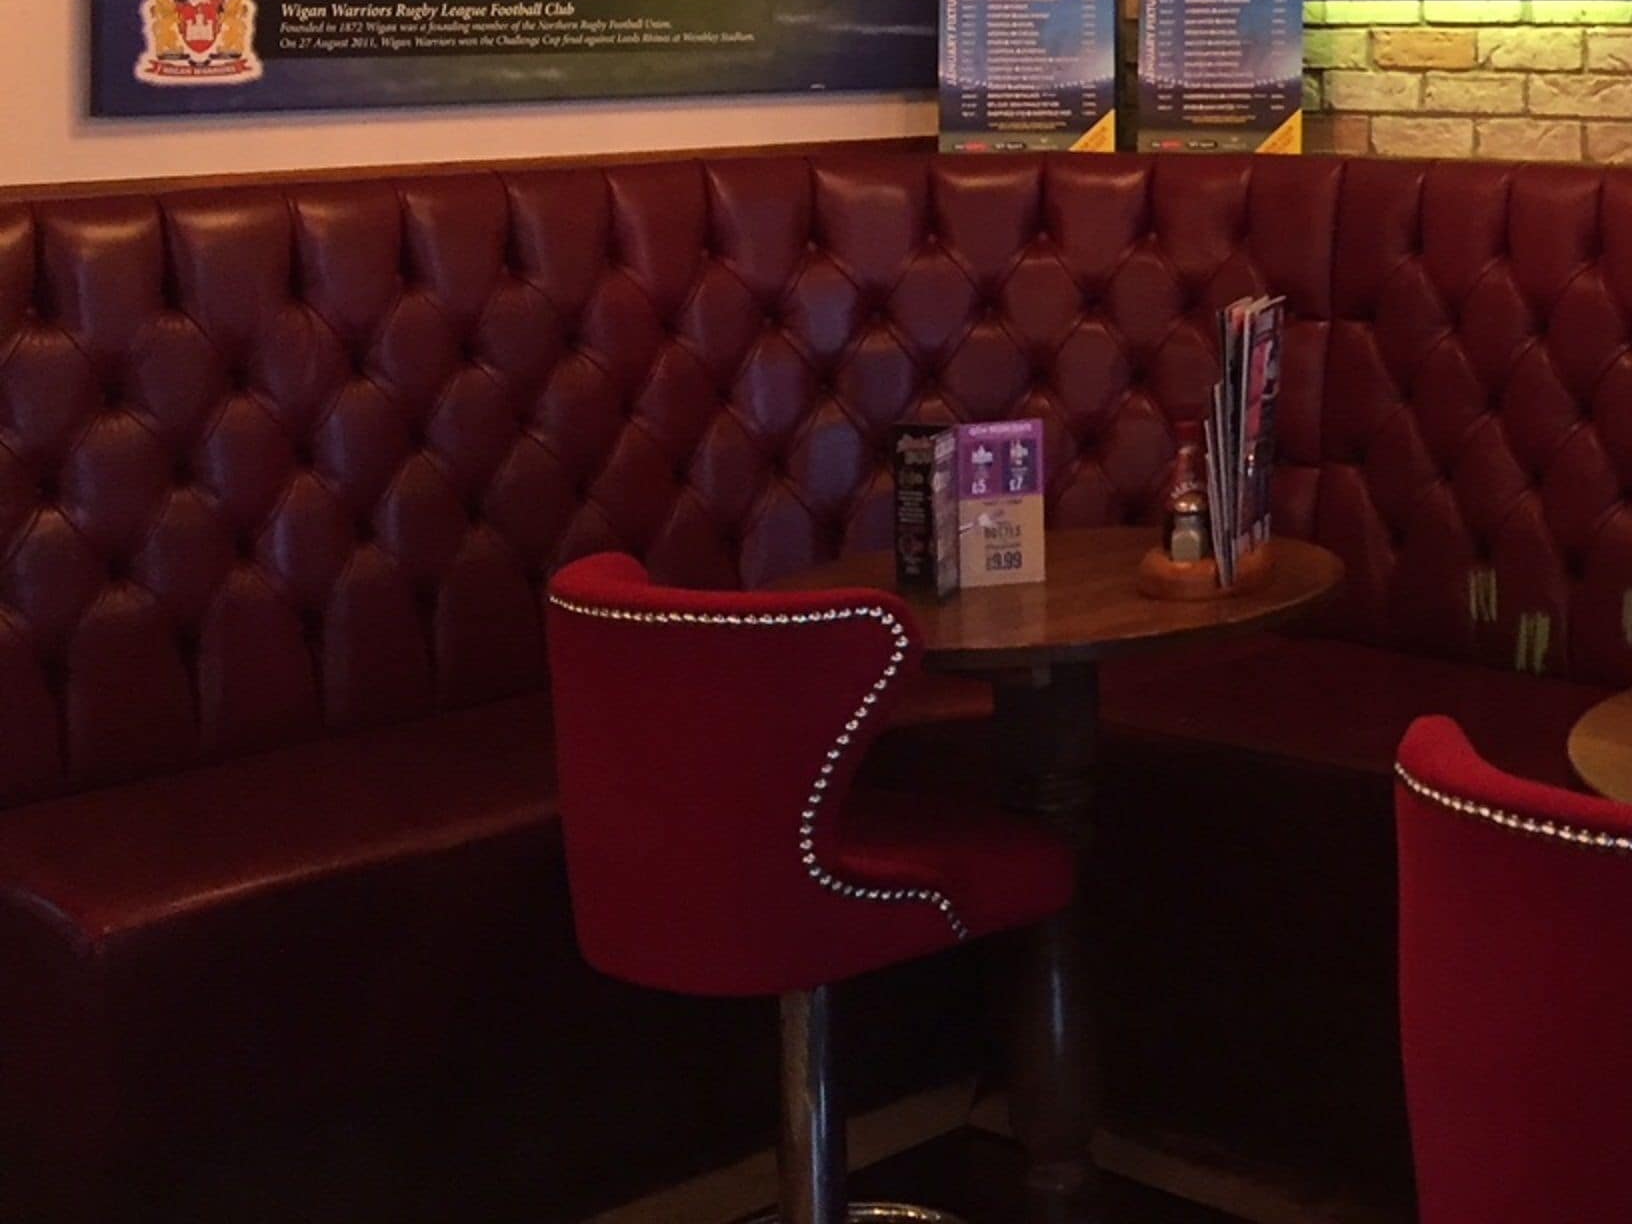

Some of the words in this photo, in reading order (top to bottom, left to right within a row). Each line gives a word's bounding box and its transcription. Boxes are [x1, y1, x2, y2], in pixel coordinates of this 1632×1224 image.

[280, 2, 327, 22] Wigan
[331, 3, 394, 18] Warriors
[395, 2, 439, 22] Rugby
[441, 2, 487, 21] League
[490, 1, 543, 18] Football
[545, 1, 576, 17] Club
[279, 21, 324, 34] Founded
[325, 23, 337, 33] in
[365, 22, 398, 36] Wigan
[399, 24, 419, 33] was
[521, 20, 535, 31] the
[279, 37, 297, 49] On
[298, 37, 312, 49] 27
[313, 37, 349, 52] August
[381, 36, 412, 51] Wigan
[414, 36, 456, 47] Warriors
[971, 478, 987, 496] £5
[985, 550, 1023, 572] £9.99
